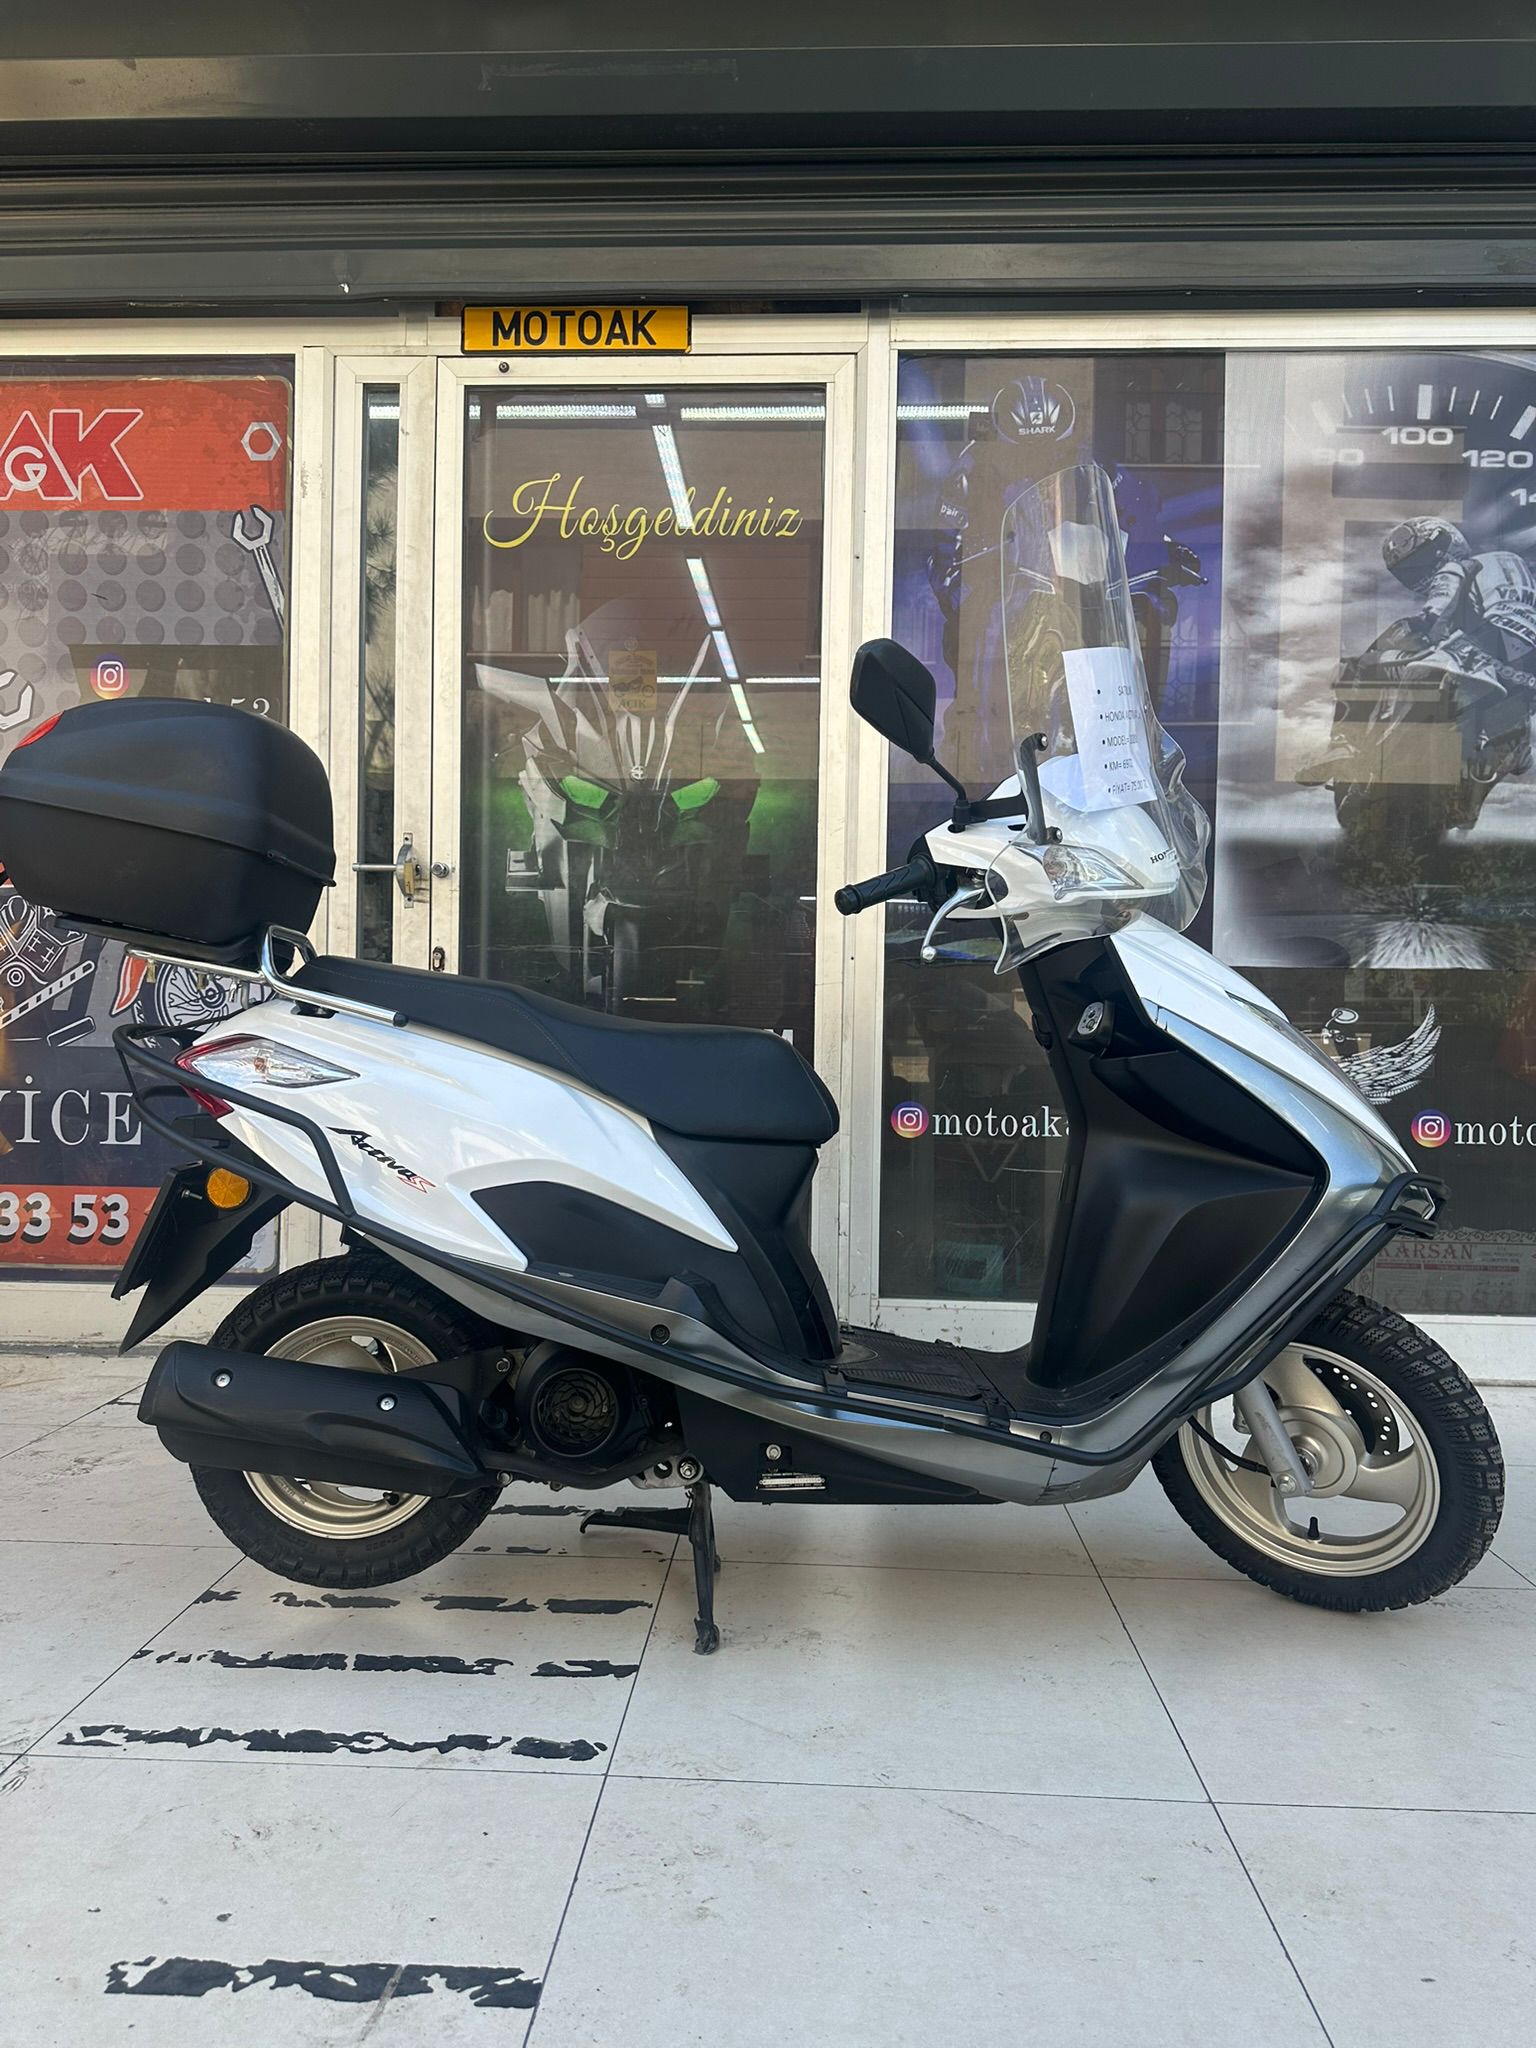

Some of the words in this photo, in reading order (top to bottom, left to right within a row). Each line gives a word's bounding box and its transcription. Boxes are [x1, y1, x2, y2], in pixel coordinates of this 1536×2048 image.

[491, 310, 657, 347] MOTOAK
[1018, 425, 1056, 436] SHARK
[1381, 426, 1454, 445] 100
[1461, 449, 1534, 469] 120
[483, 472, 803, 560] Hoşgeldiniz
[0, 1075, 142, 1146] İCE
[932, 1105, 1069, 1138] motoak
[68, 1193, 130, 1240] 53
